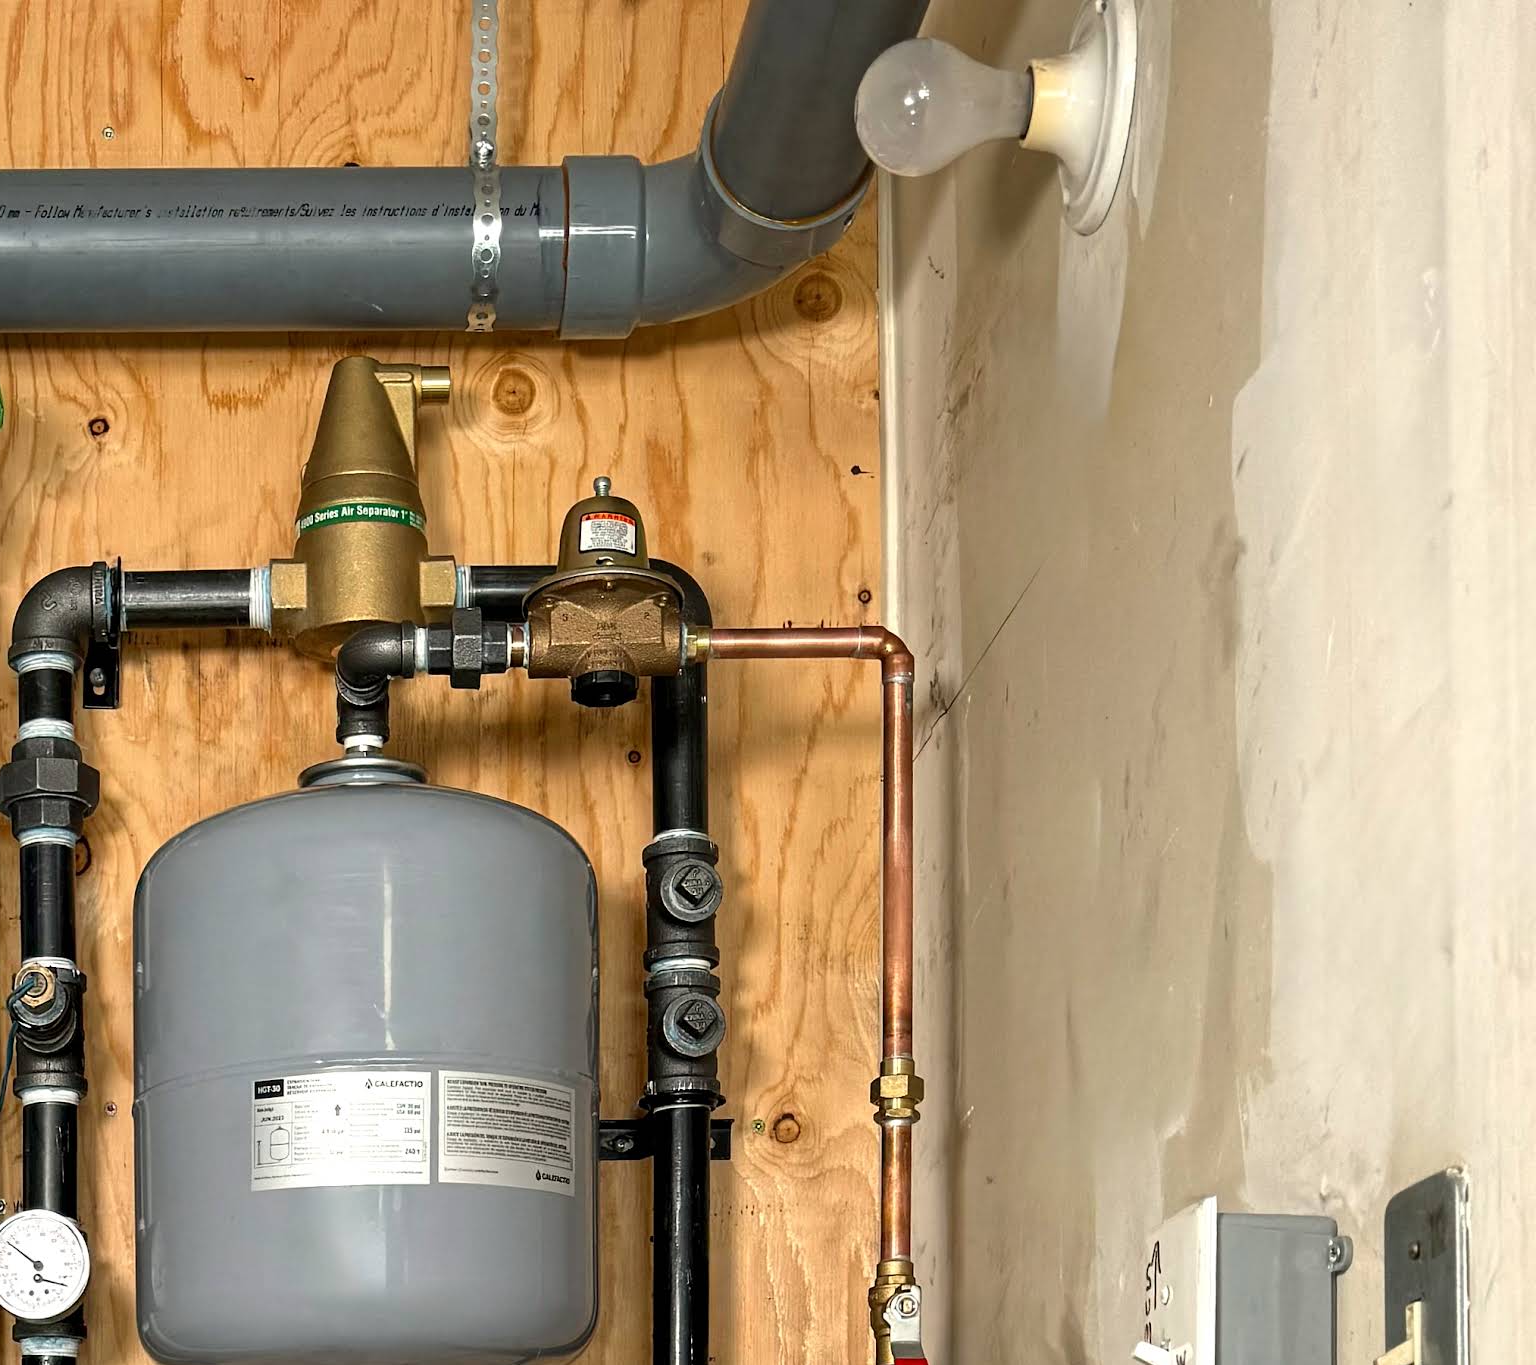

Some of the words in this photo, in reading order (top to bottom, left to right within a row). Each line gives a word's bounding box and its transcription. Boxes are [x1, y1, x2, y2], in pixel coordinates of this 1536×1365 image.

[35, 206, 69, 219] Follow
[363, 205, 432, 218] instructions
[514, 206, 527, 218] du
[315, 509, 339, 523] Series
[341, 506, 355, 517] Air
[357, 506, 400, 519] Separator
[375, 1080, 423, 1089] CALEFACTIO
